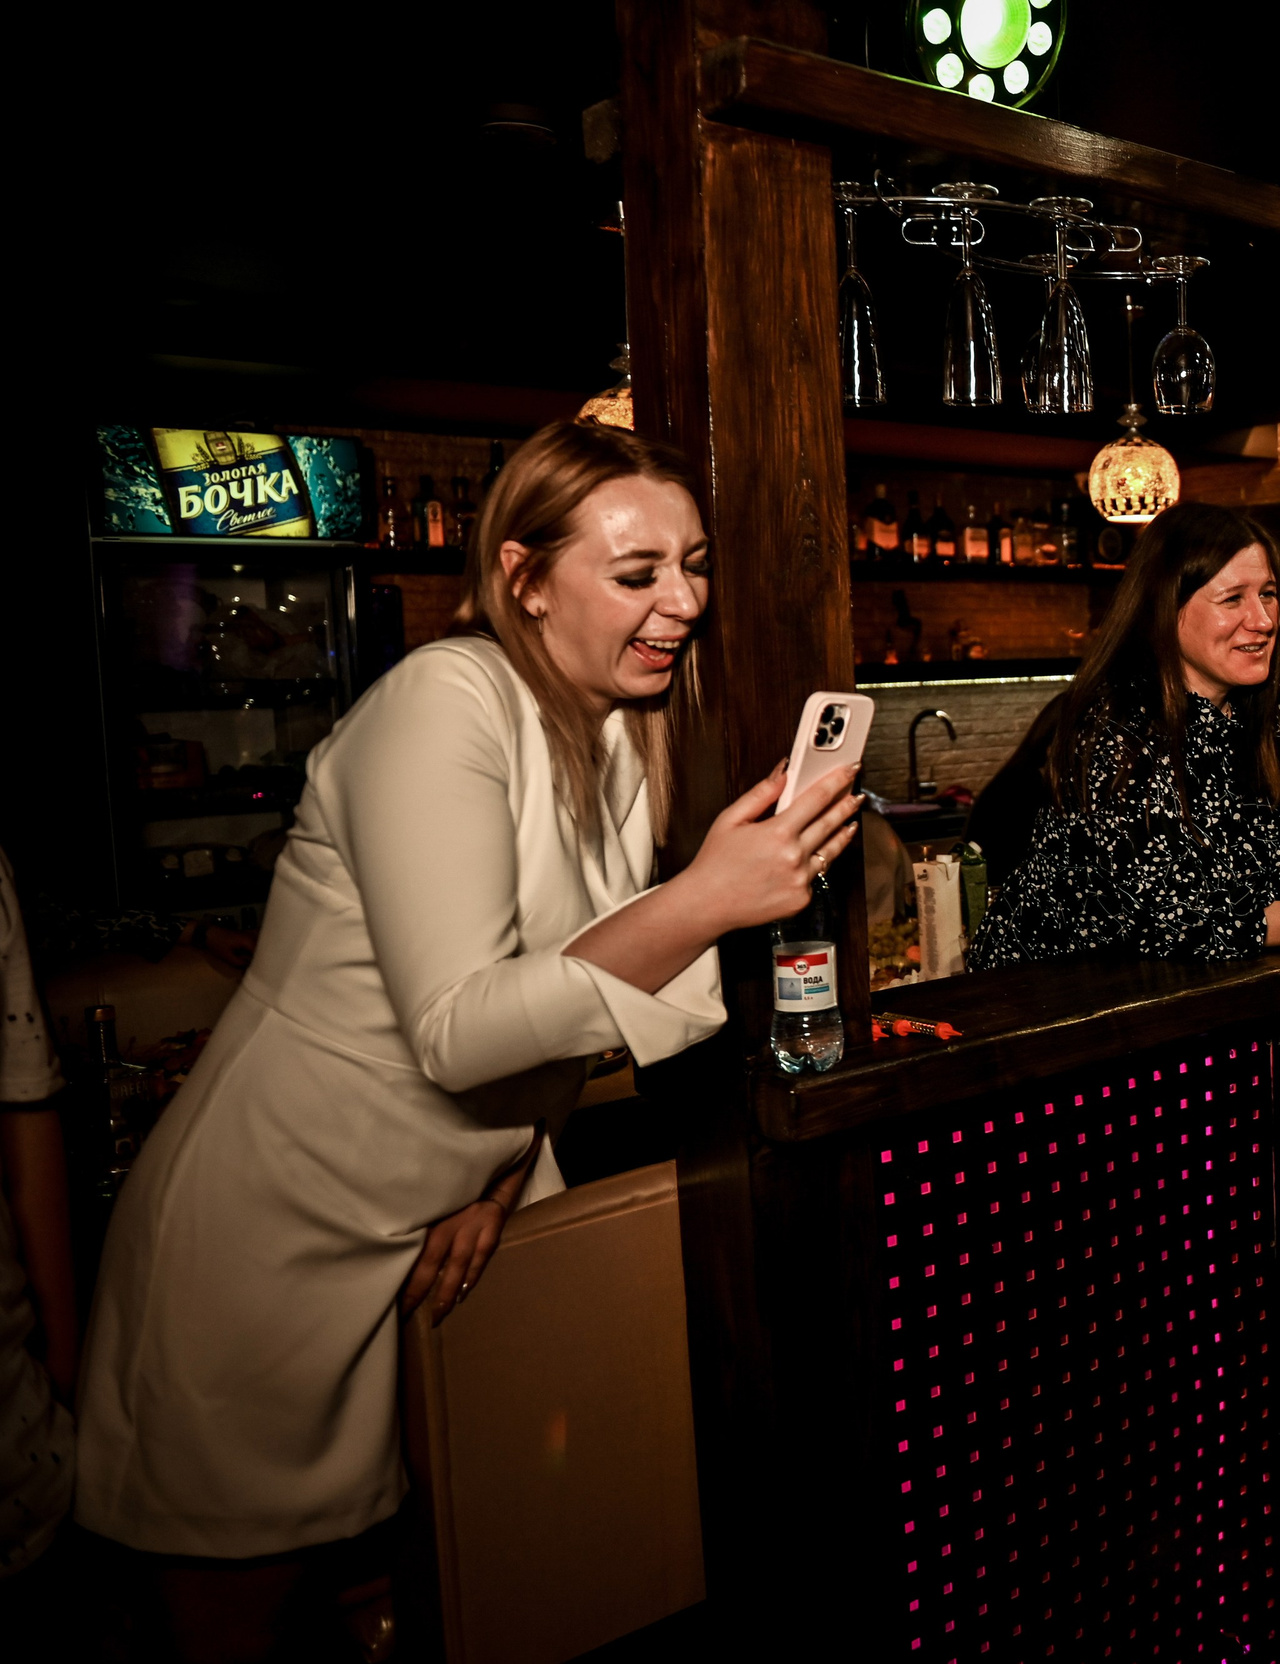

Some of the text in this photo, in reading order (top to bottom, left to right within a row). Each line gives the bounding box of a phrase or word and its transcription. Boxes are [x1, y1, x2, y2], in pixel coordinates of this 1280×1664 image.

[203, 462, 267, 487] ЗОЛОТАЯ
[178, 469, 299, 519] БОЧКА
[216, 507, 276, 532] Светлое
[803, 976, 823, 984] ВОДА
